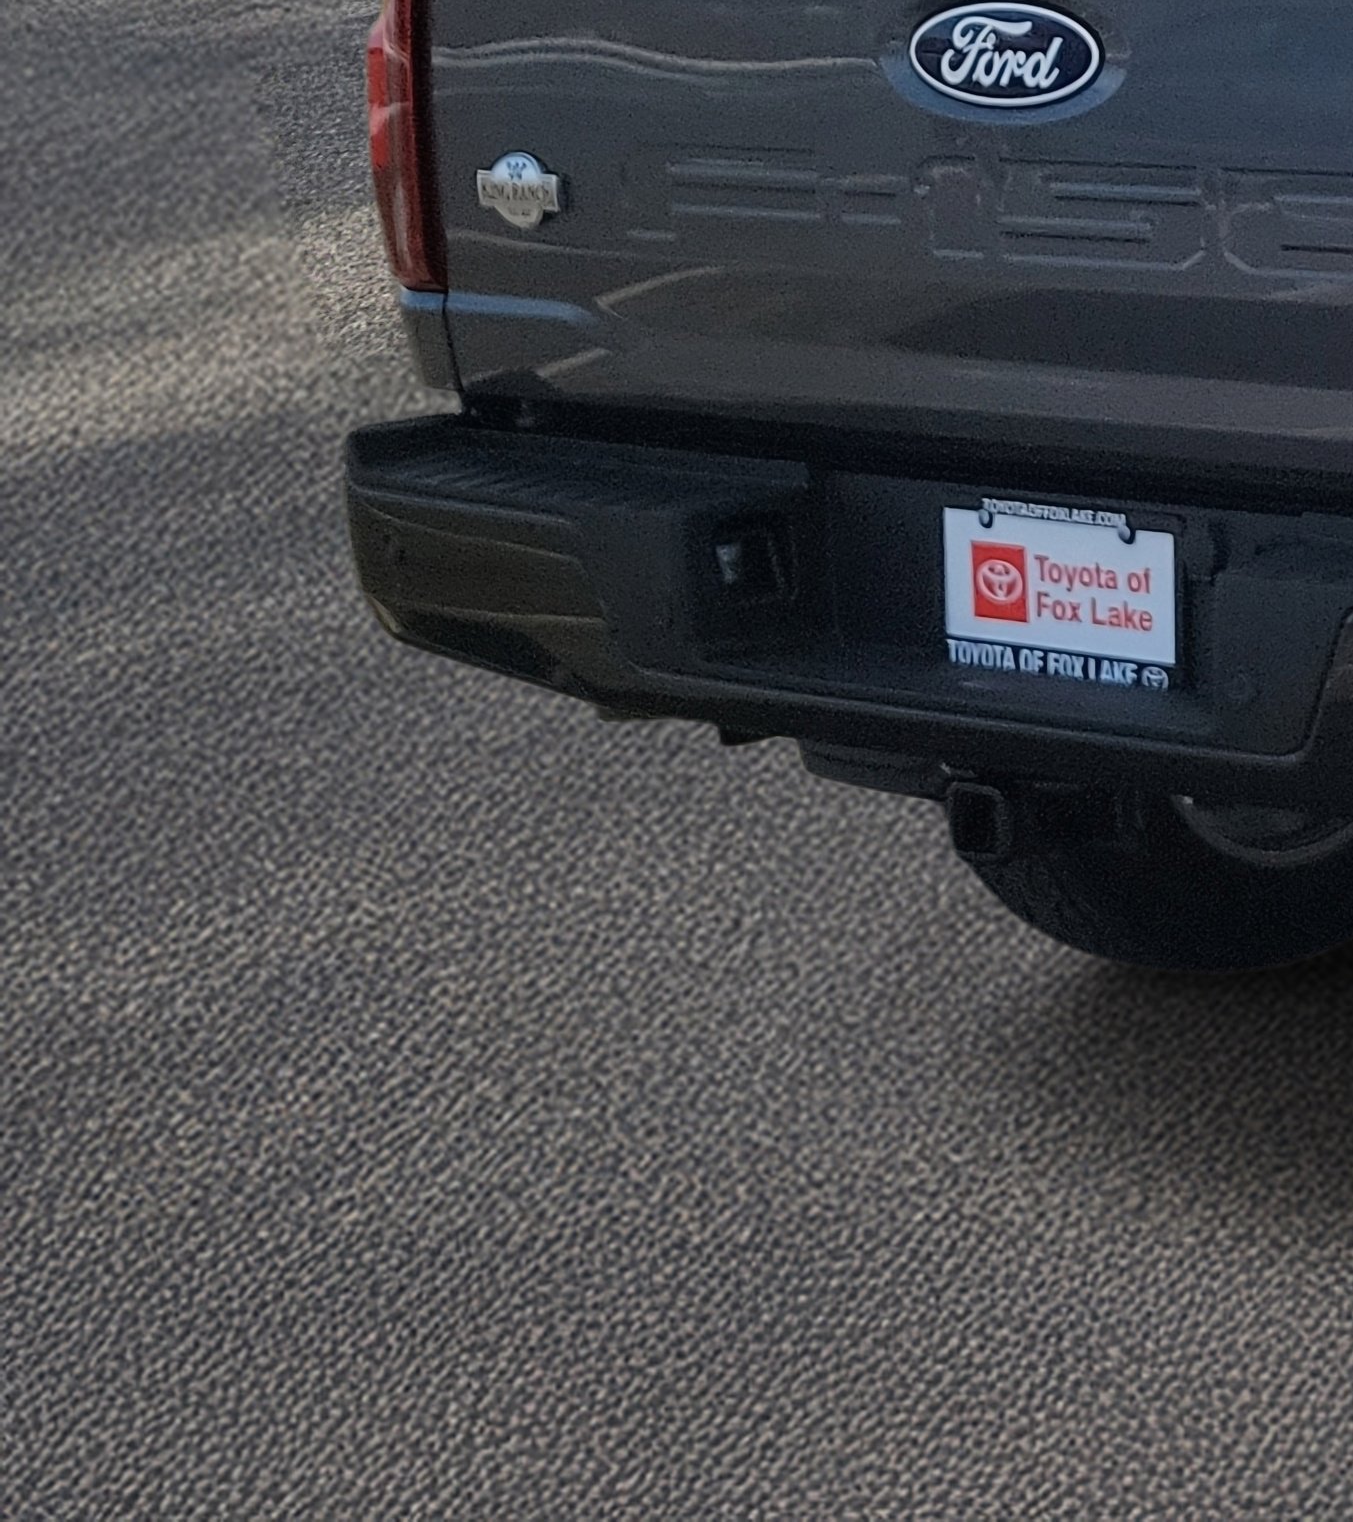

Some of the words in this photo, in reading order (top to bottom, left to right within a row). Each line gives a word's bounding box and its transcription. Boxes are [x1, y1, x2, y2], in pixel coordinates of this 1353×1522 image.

[941, 15, 1064, 89] Ford
[1033, 553, 1118, 592] Toyota
[1127, 567, 1152, 595] of
[1036, 590, 1083, 623] Fox
[1091, 596, 1153, 632] Lake
[946, 638, 1016, 671] TOYOTA
[1018, 647, 1045, 676] OF
[1047, 651, 1085, 679] FOX
[1087, 657, 1139, 687] LAKE
